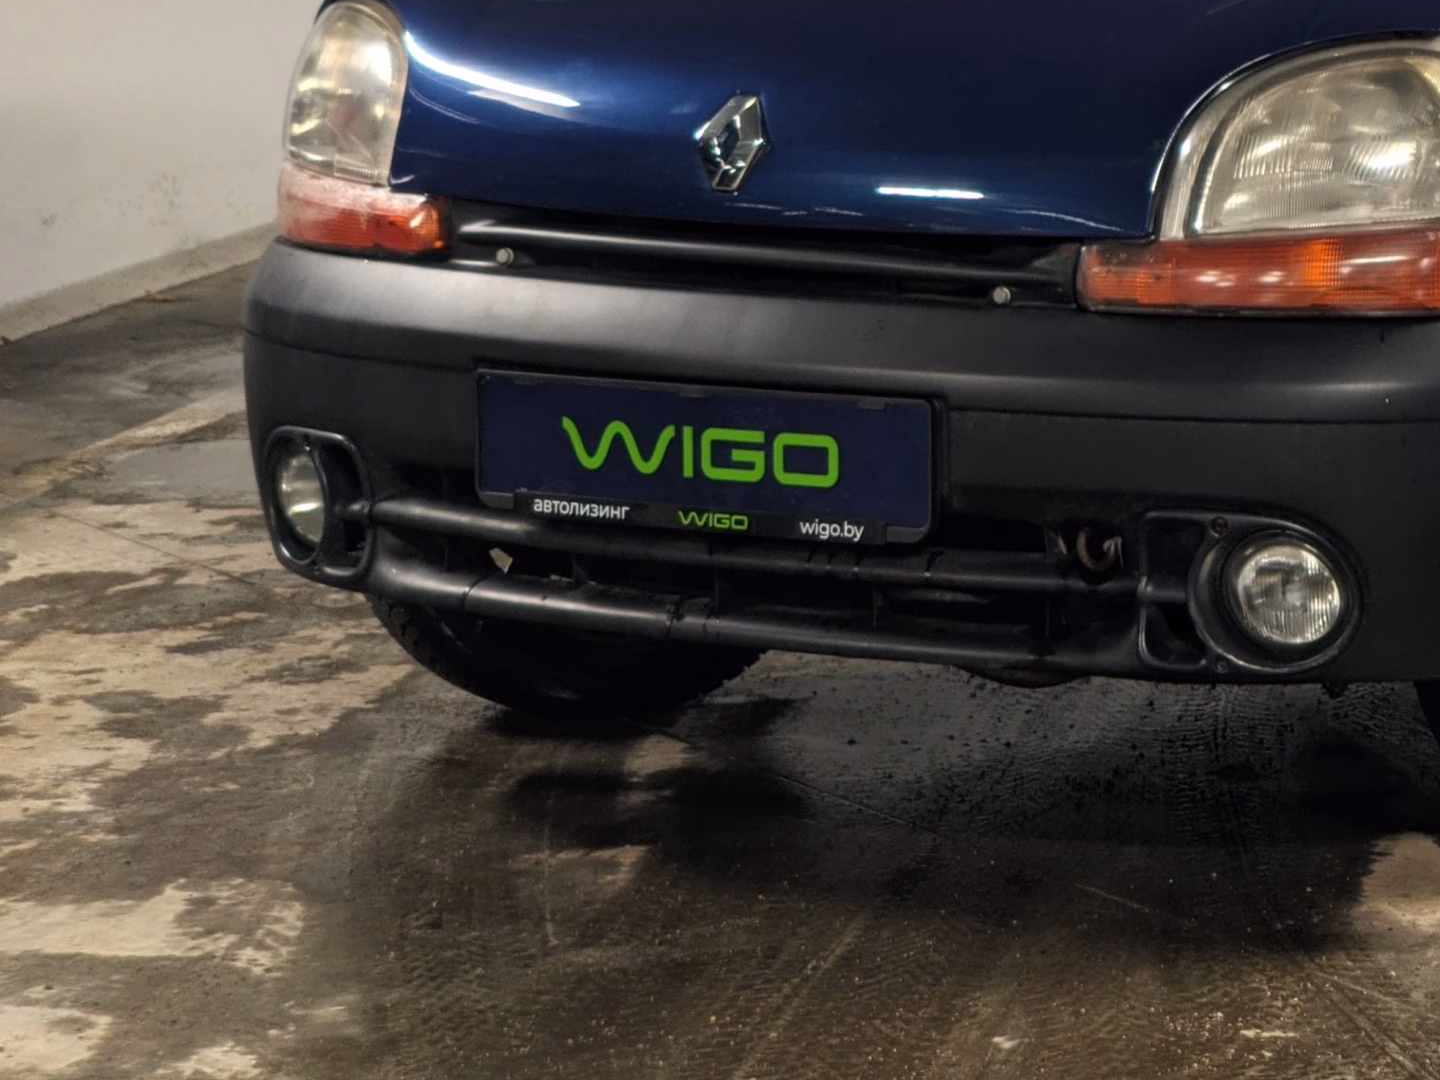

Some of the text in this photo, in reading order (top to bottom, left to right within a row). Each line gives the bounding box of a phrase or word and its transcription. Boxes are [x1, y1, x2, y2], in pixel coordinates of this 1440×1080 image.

[561, 416, 839, 488] WIGO
[533, 498, 630, 520] автолизинг
[678, 510, 749, 530] WIGO
[799, 518, 864, 542] wigo.by
